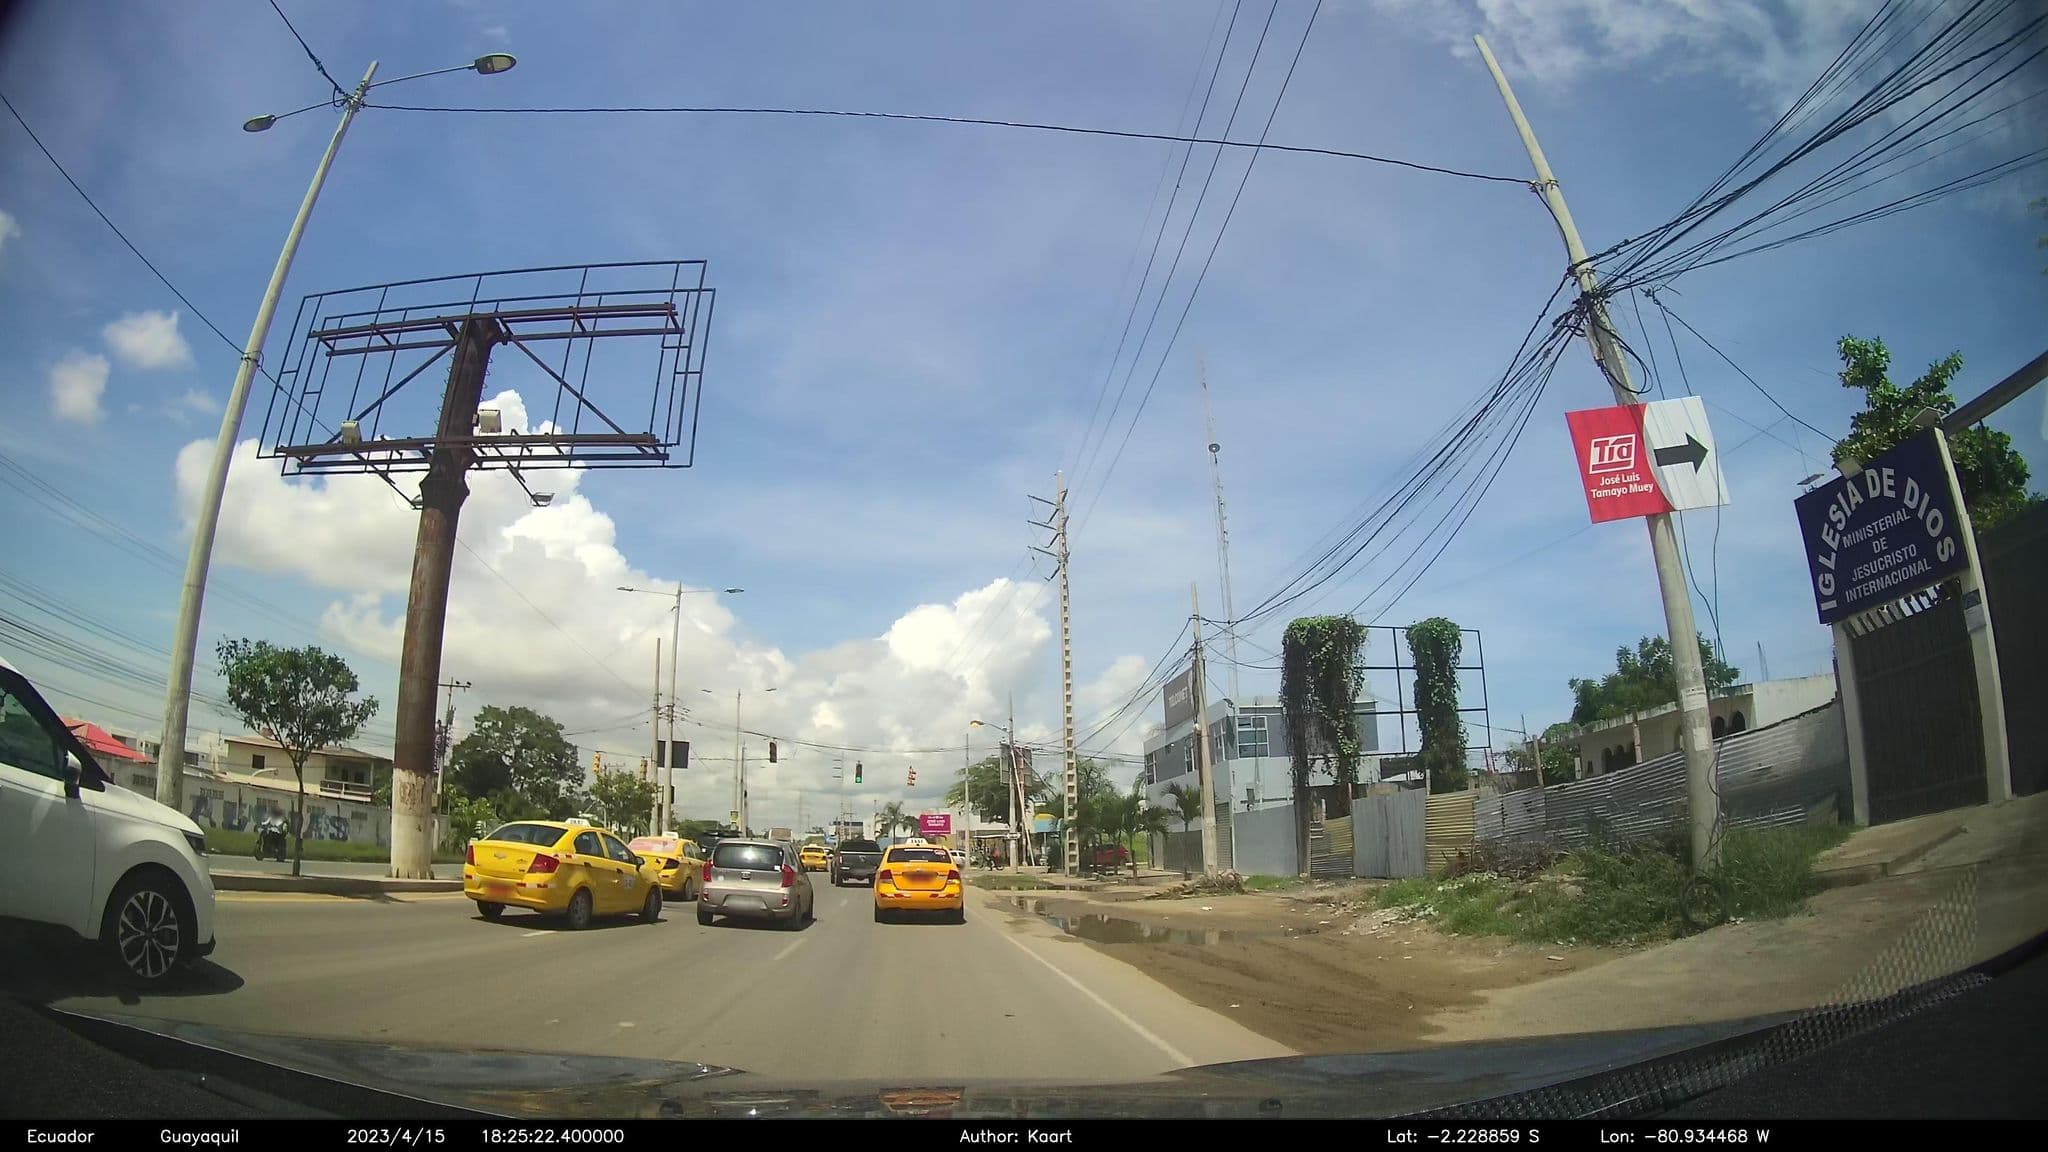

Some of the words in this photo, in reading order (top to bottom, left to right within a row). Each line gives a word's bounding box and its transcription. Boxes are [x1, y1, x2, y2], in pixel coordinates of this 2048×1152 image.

[1591, 486, 1627, 498] Tamayo
[1629, 483, 1654, 494] Muey
[1600, 474, 1620, 486] José
[1621, 472, 1640, 483] Luis
[1818, 480, 1864, 611] IGLESIA
[1865, 467, 1896, 499] DE
[1903, 477, 1955, 562] DIOS
[1843, 508, 1911, 549] MINISTERIAL
[1872, 537, 1888, 554] DE
[1846, 558, 1932, 603] INTERNACIONAL
[1852, 543, 1917, 582] JESUCRISTO
